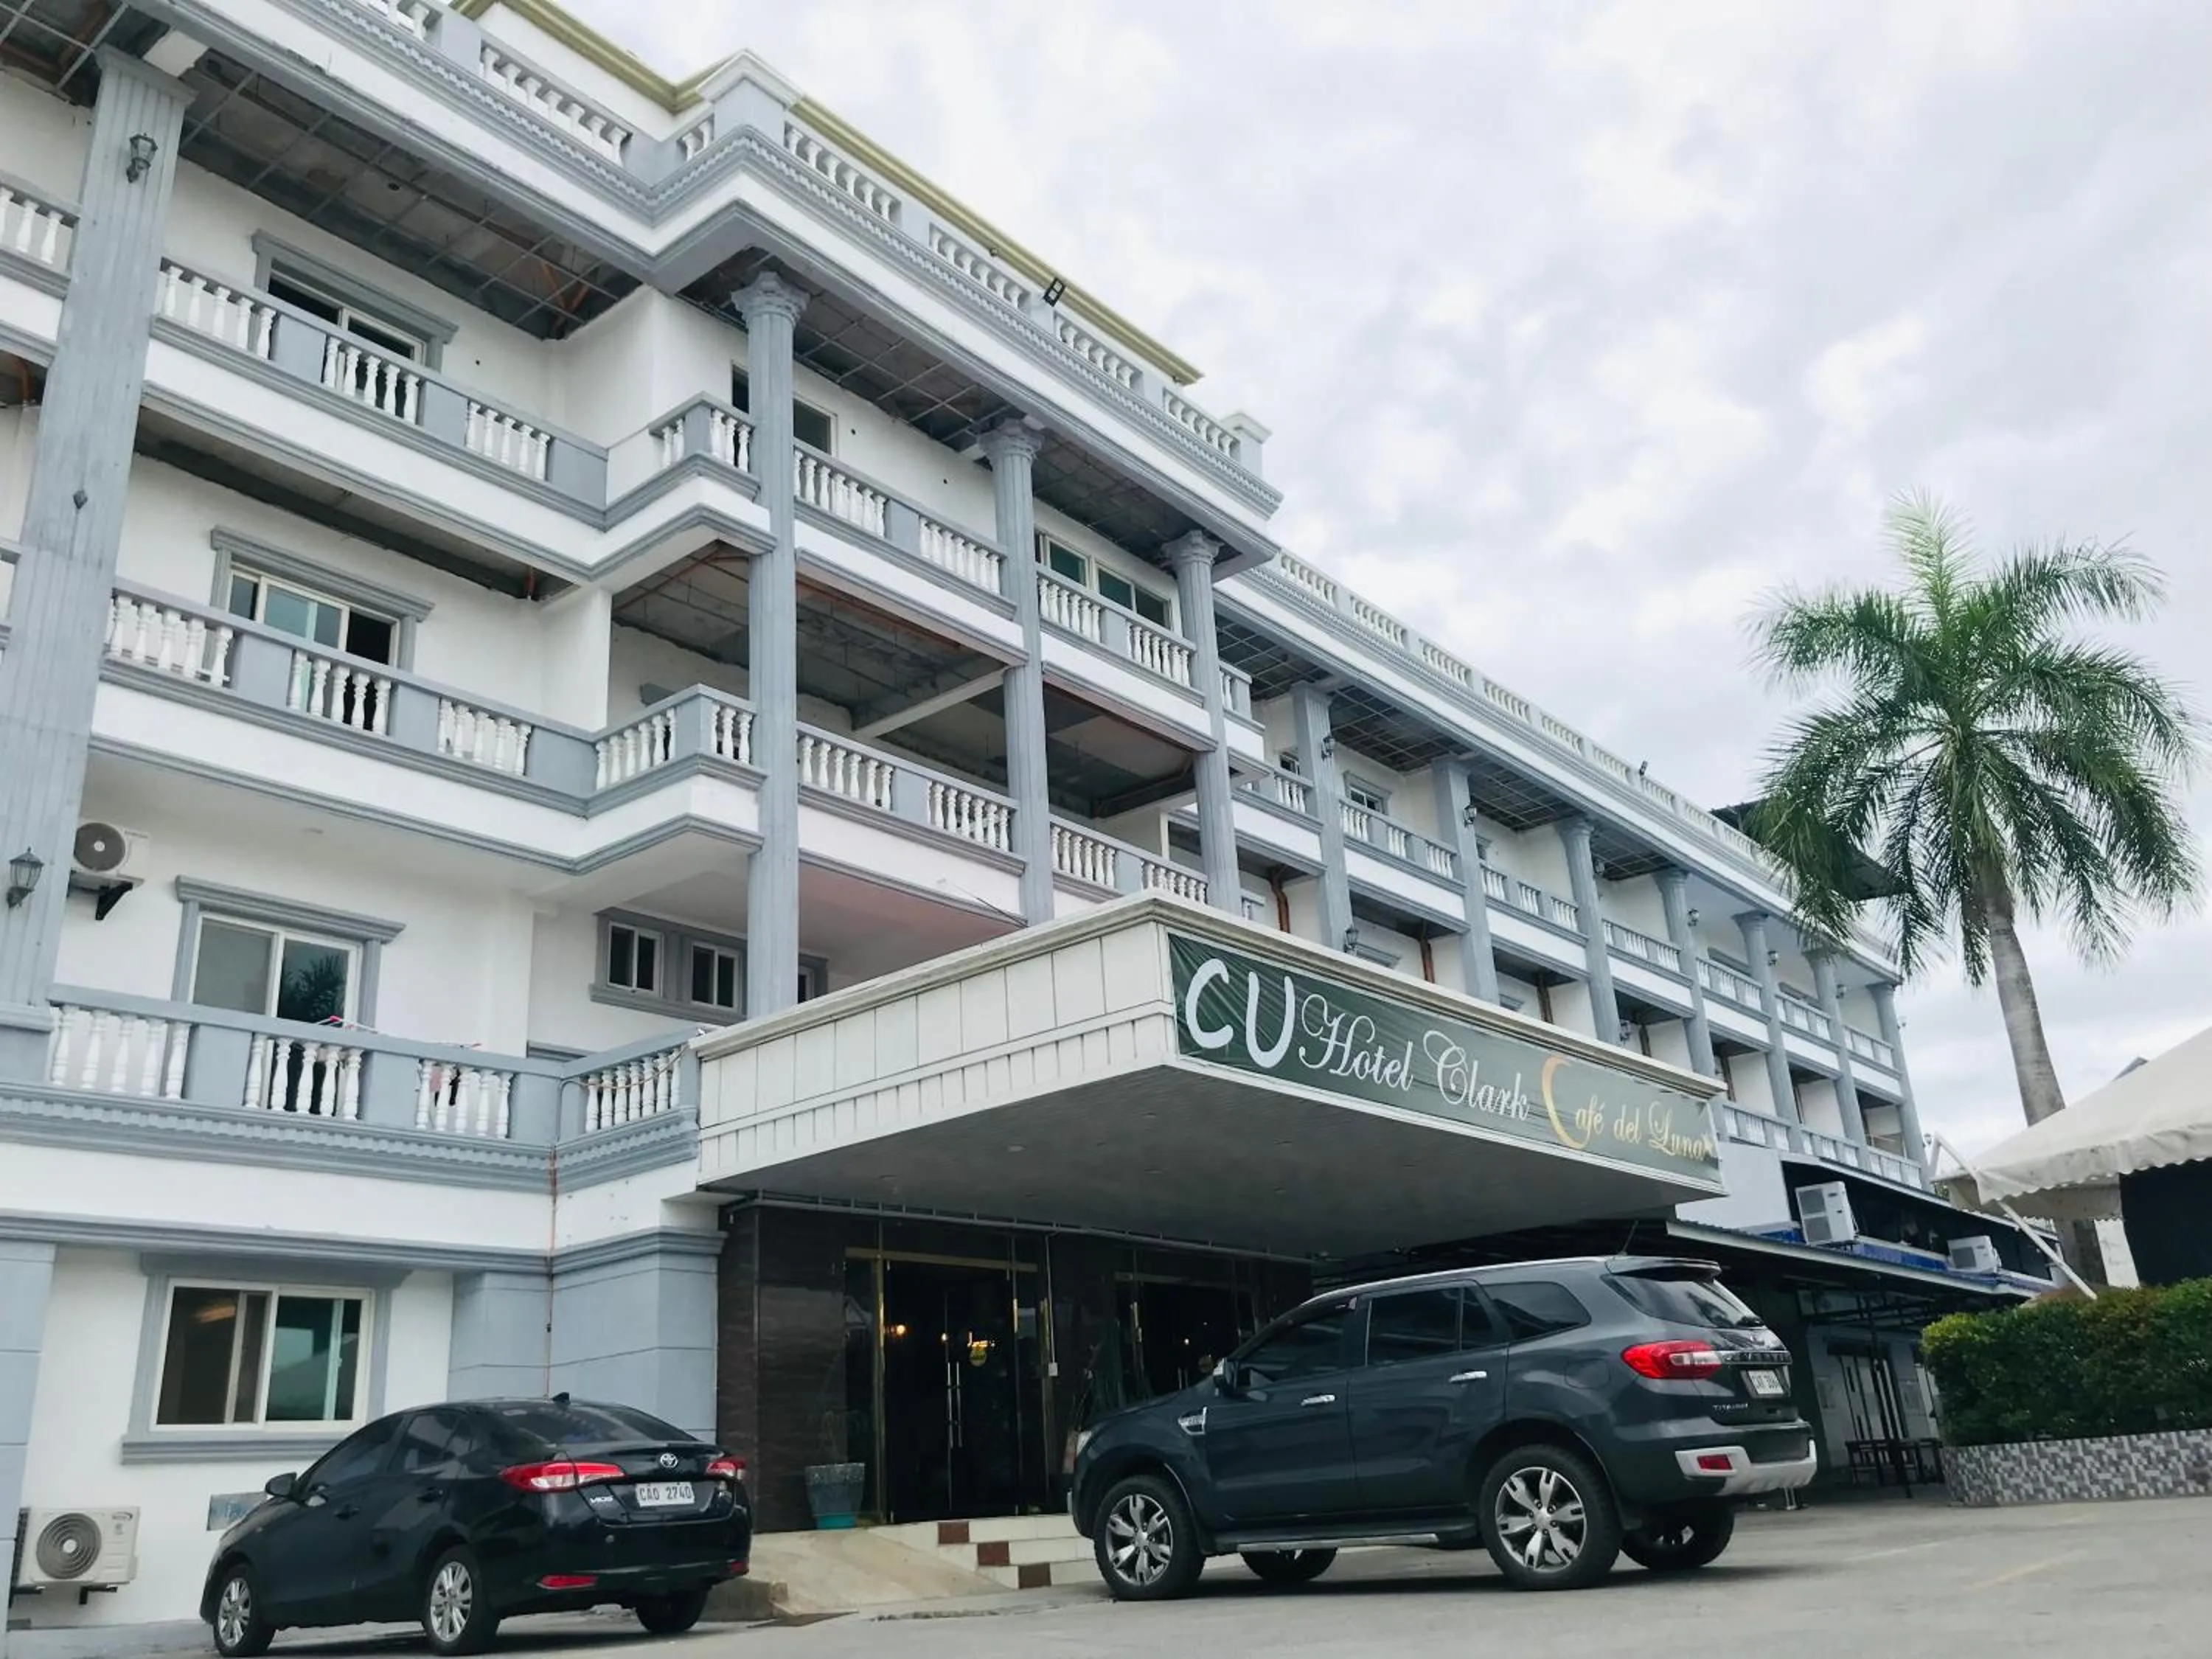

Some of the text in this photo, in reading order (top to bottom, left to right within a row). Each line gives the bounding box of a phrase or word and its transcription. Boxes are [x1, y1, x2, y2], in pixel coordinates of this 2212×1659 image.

[1186, 959, 1531, 1121] CU Hotel Clark
[1542, 1054, 1605, 1150] Café
[1613, 1104, 1642, 1144] del
[666, 1485, 692, 1500] 2740
